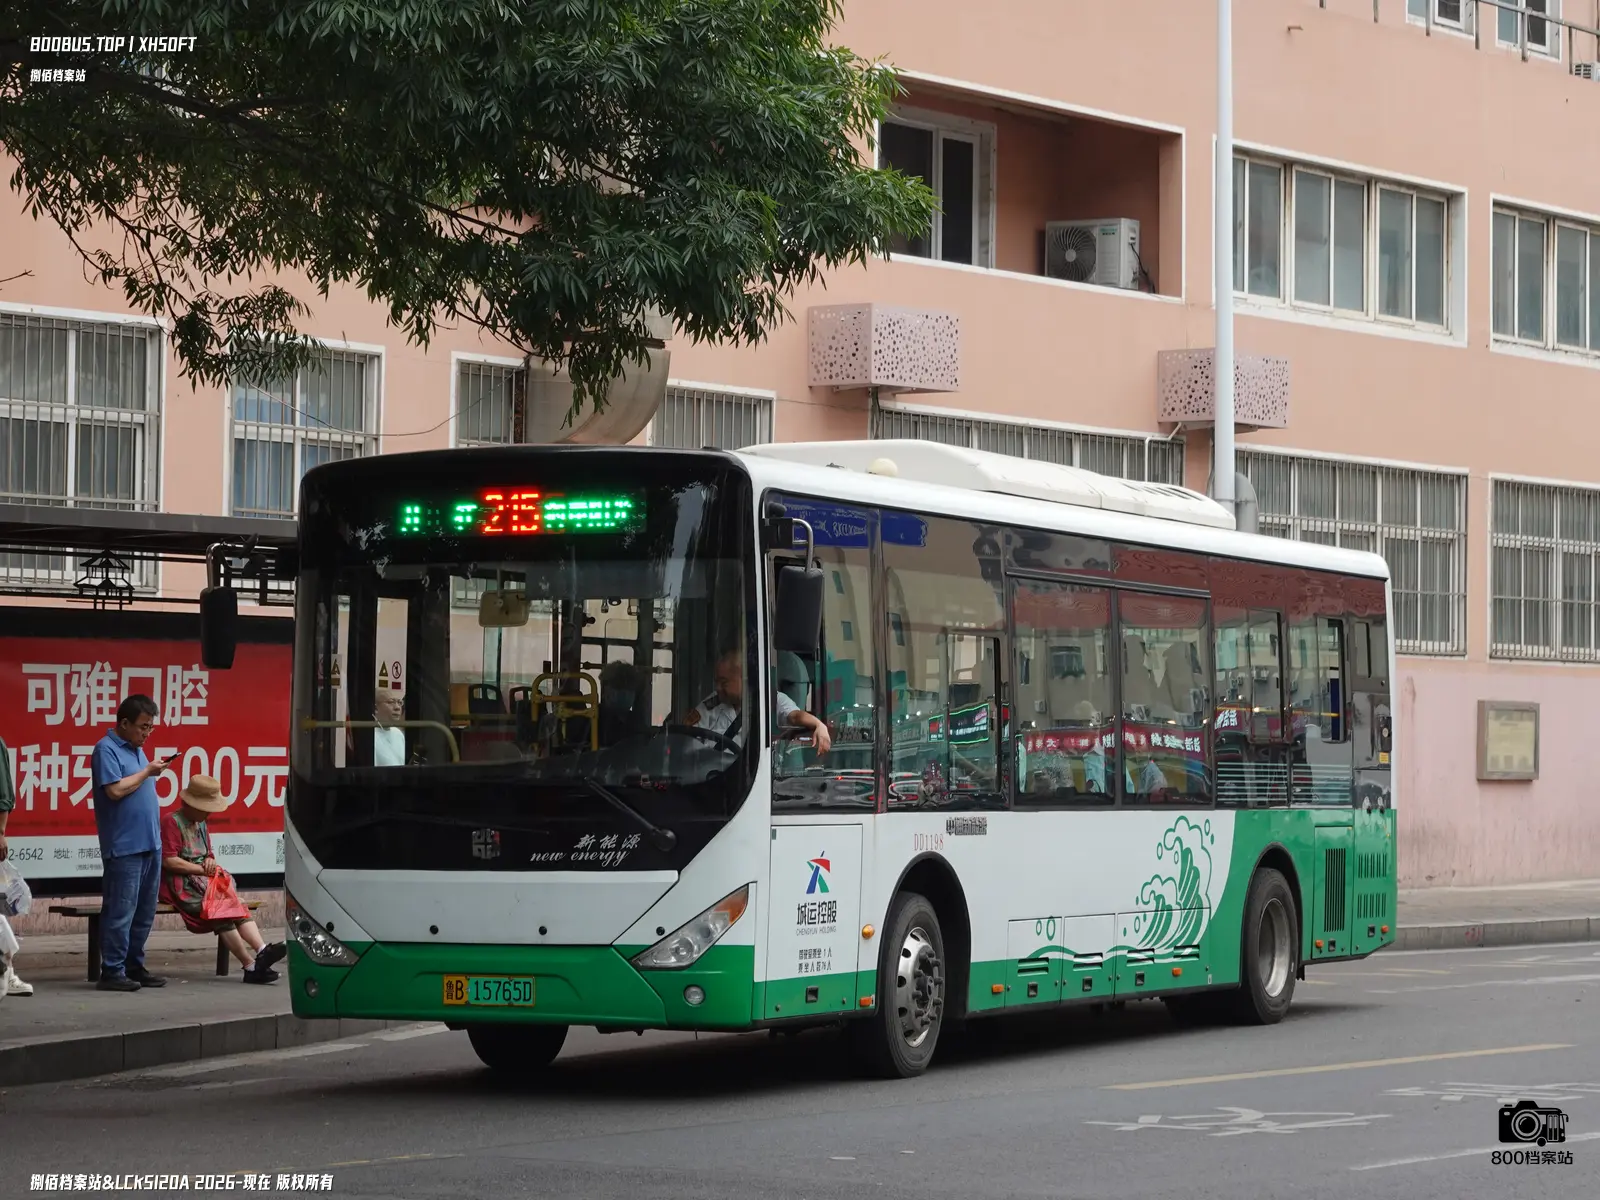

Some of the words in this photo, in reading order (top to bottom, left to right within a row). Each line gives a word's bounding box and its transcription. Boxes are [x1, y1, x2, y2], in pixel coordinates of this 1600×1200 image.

[22, 660, 209, 727] 可雅口腔
[573, 834, 641, 850] 新能源
[8, 848, 43, 861] 2-6542
[530, 851, 565, 862] new
[570, 850, 630, 867] energy
[797, 900, 837, 926] 城运控股
[796, 925, 818, 936] CHENGYUN
[819, 921, 837, 934] HOLDING
[474, 980, 532, 1002] 15765D
